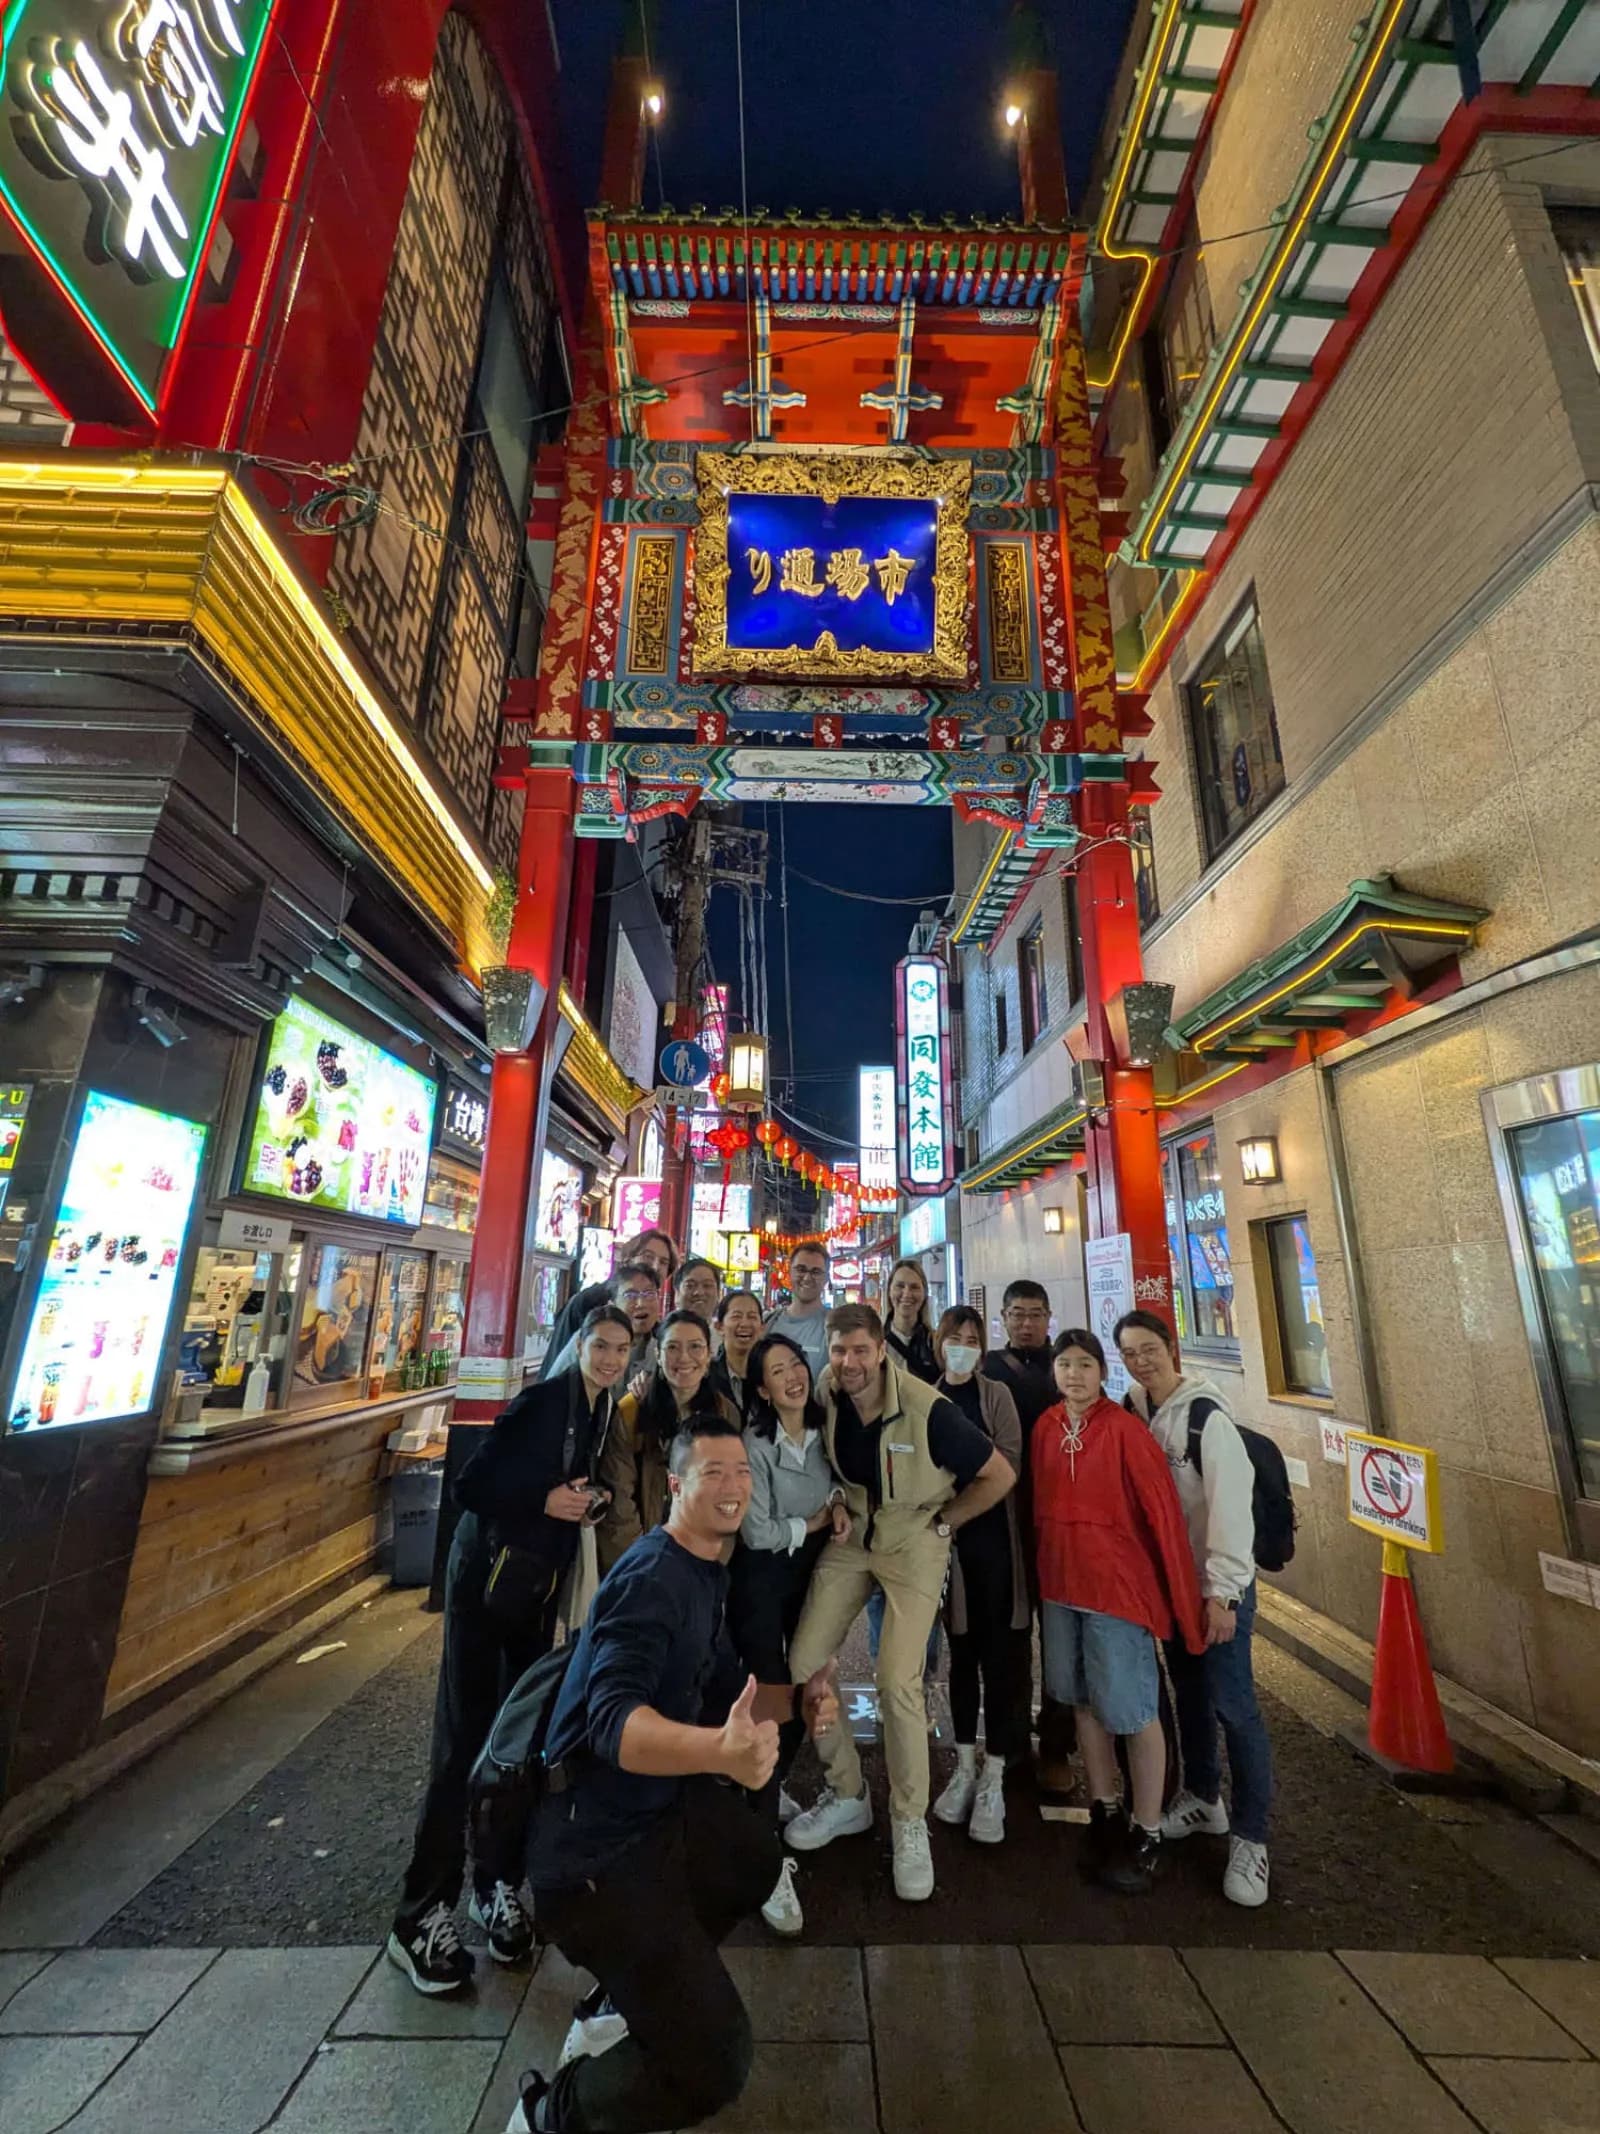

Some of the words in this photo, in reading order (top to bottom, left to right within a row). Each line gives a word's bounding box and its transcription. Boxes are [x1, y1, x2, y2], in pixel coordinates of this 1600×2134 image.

[51, 0, 247, 280] 府井
[745, 547, 916, 606] 市場通り
[909, 1033, 940, 1171] 同發本館
[1351, 1498, 1363, 1513] No
[1395, 1516, 1426, 1541] drinking
